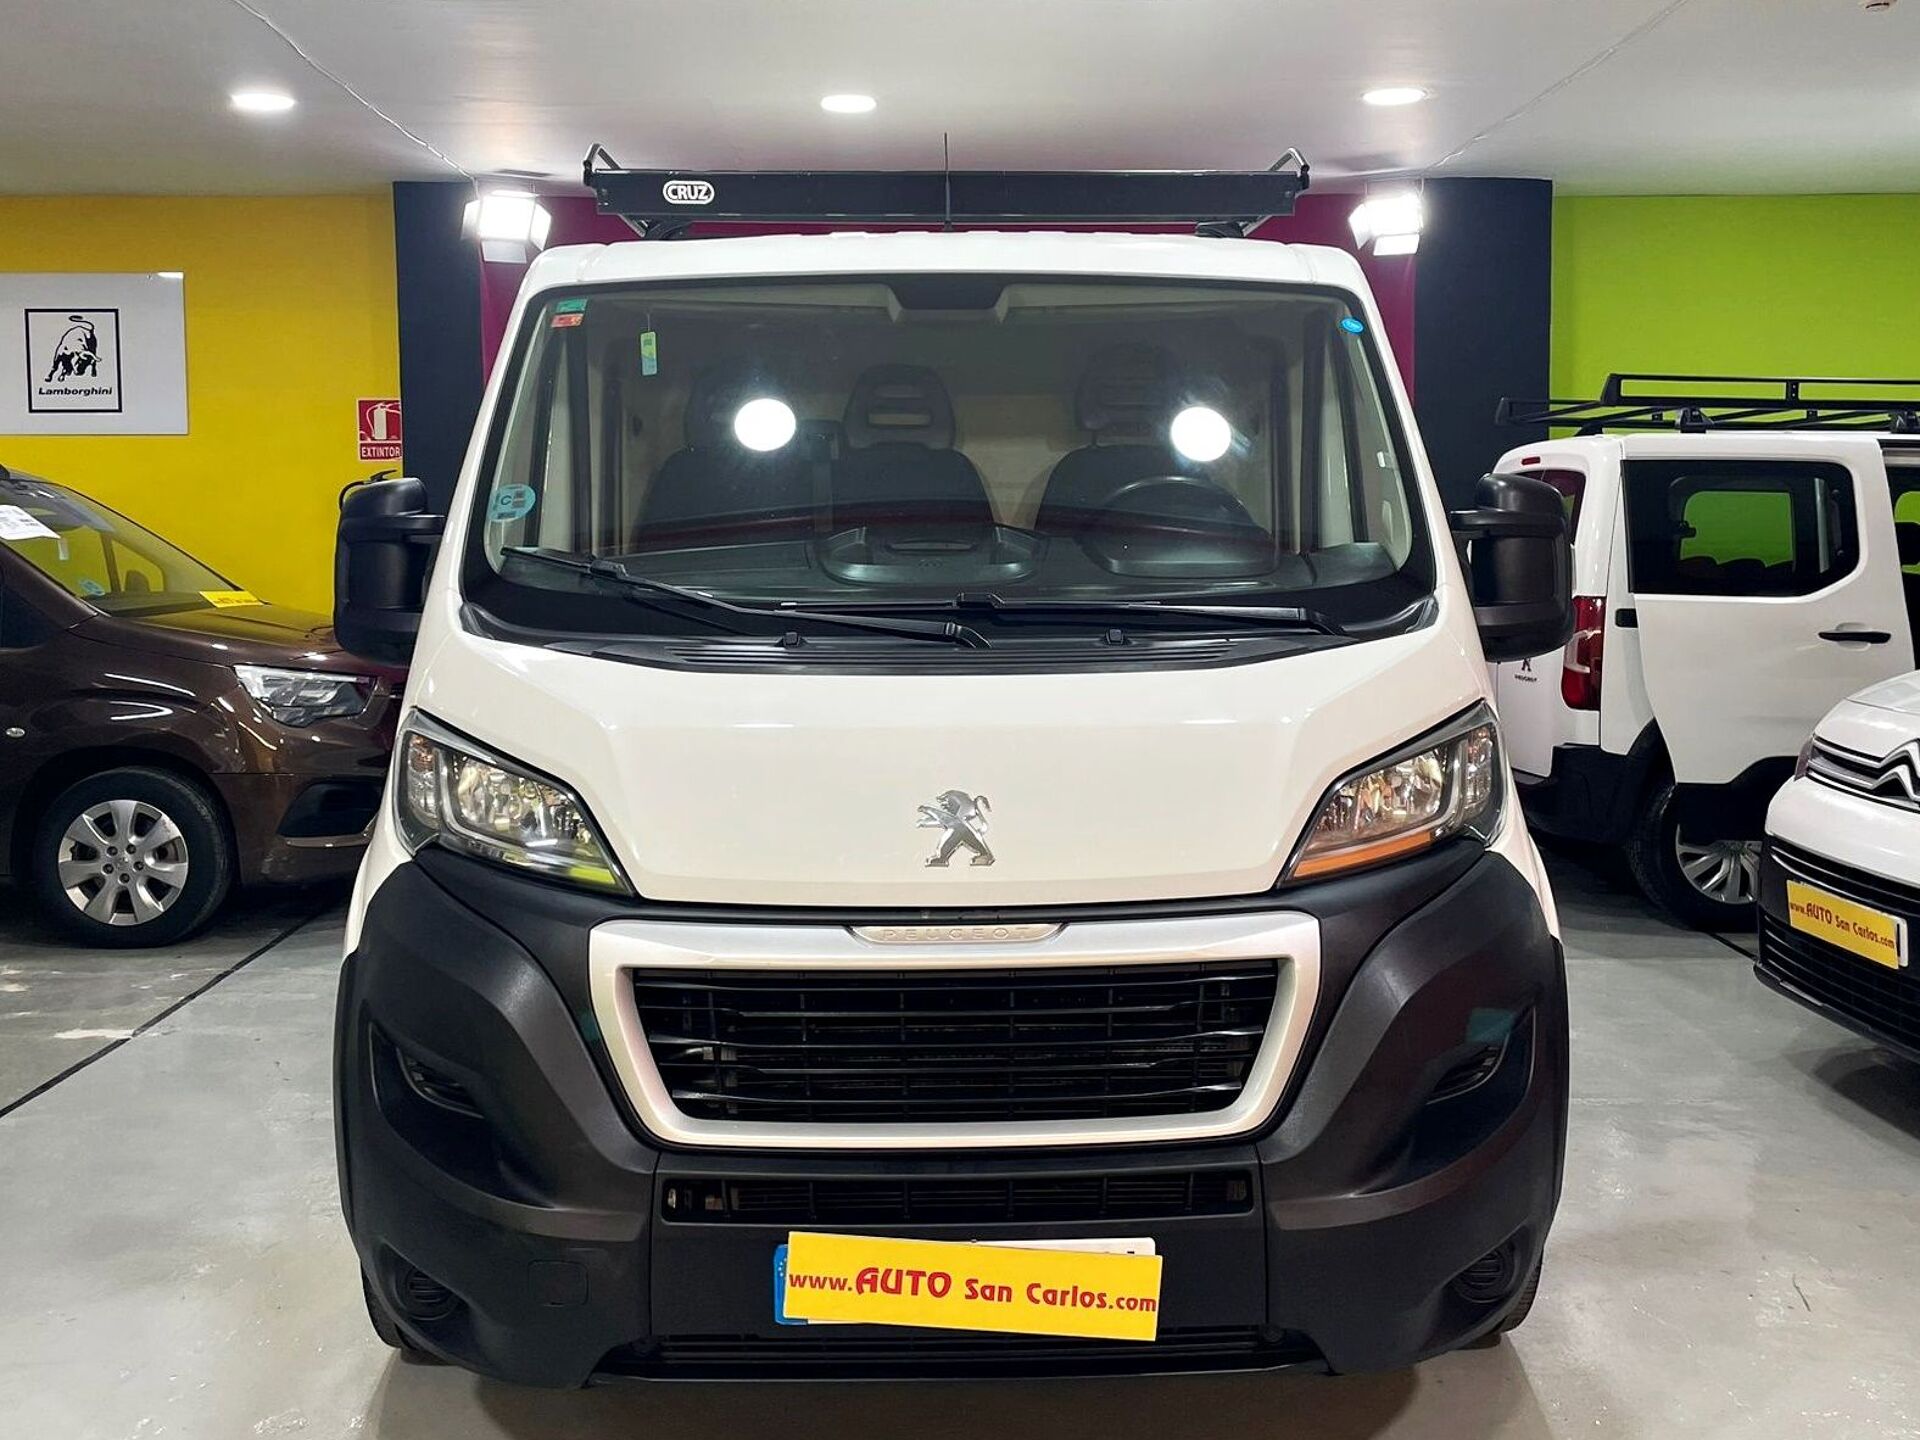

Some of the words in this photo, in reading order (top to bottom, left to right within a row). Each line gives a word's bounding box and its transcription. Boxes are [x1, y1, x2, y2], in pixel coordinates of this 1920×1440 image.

[667, 185, 709, 200] CRUZ
[38, 387, 113, 396] Lamborghini
[361, 446, 401, 457] EXTINTOR
[883, 927, 1030, 940] PEUGEOT
[964, 1278, 1012, 1302] San
[1026, 1283, 1157, 1312] Carlos.com
